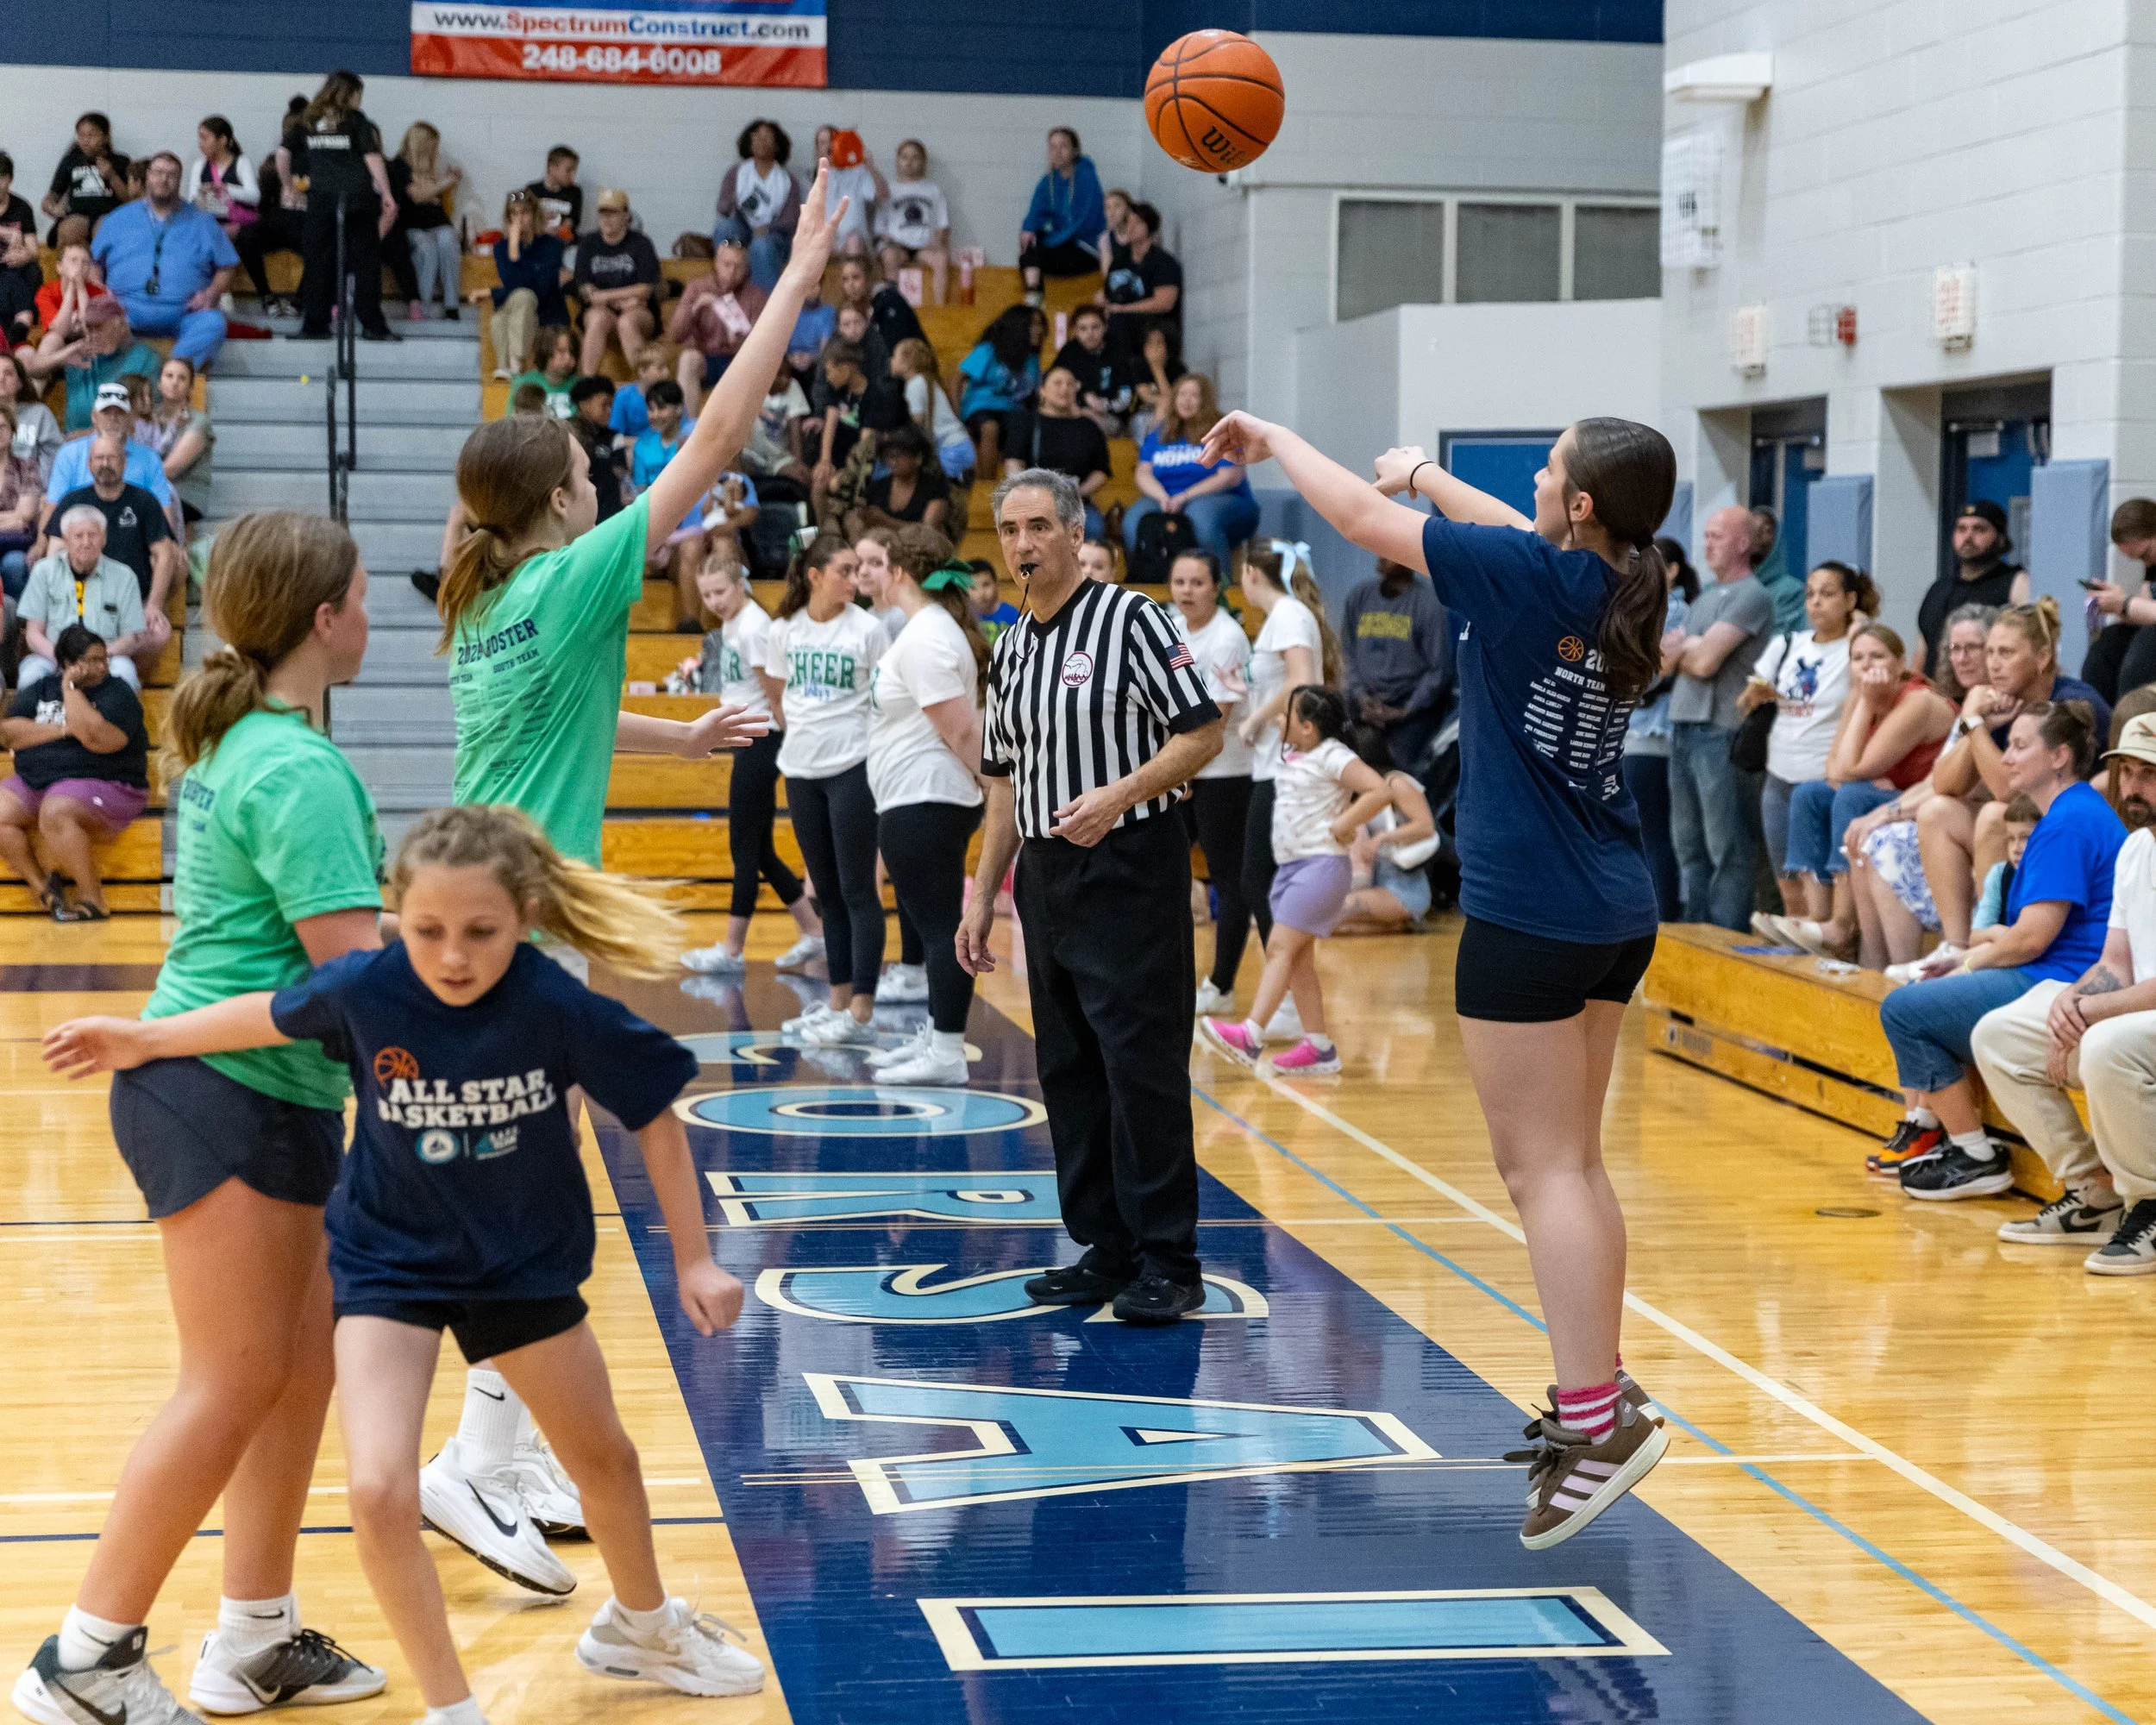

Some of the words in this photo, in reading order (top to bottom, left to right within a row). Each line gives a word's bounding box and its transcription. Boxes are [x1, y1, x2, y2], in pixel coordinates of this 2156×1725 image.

[433, 9, 811, 40] www.SpectrumConstruct.com
[522, 44, 722, 74] 248-684-6008
[486, 617, 539, 659] OSTER
[517, 648, 540, 665] TEAM
[1554, 666, 1583, 686] NORTH
[1586, 678, 1607, 692] TEAM
[388, 1077, 455, 1105] ALL
[461, 1069, 546, 1104] STAR
